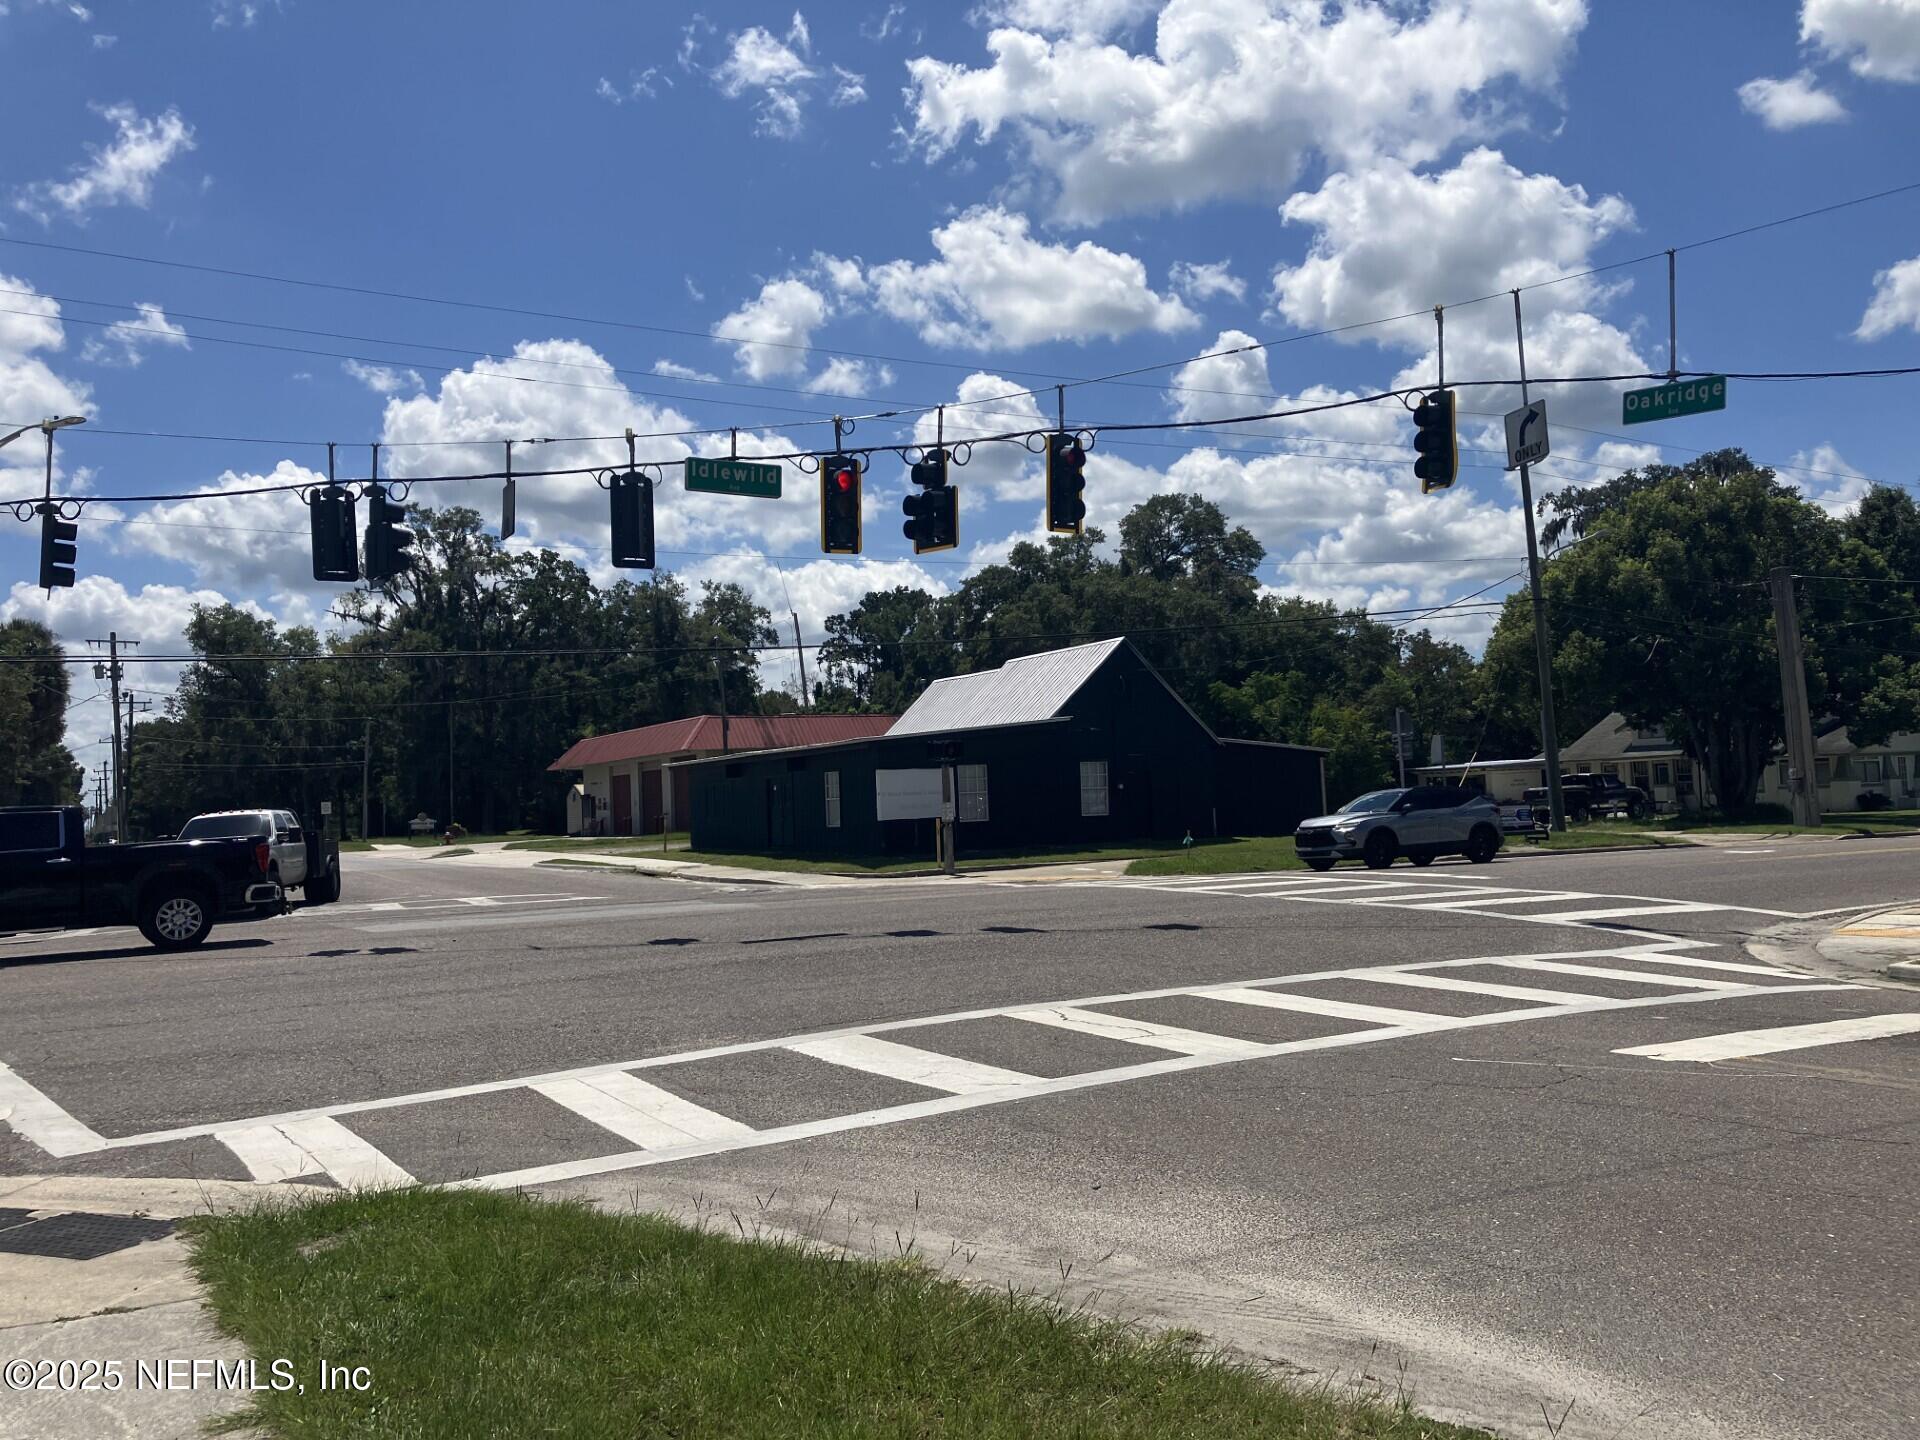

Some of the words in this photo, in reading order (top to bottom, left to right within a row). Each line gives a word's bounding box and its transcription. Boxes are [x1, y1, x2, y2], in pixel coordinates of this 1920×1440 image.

[1626, 382, 1723, 410] Oakridge
[1515, 441, 1542, 462] ONLY
[692, 461, 777, 484] Idlewild
